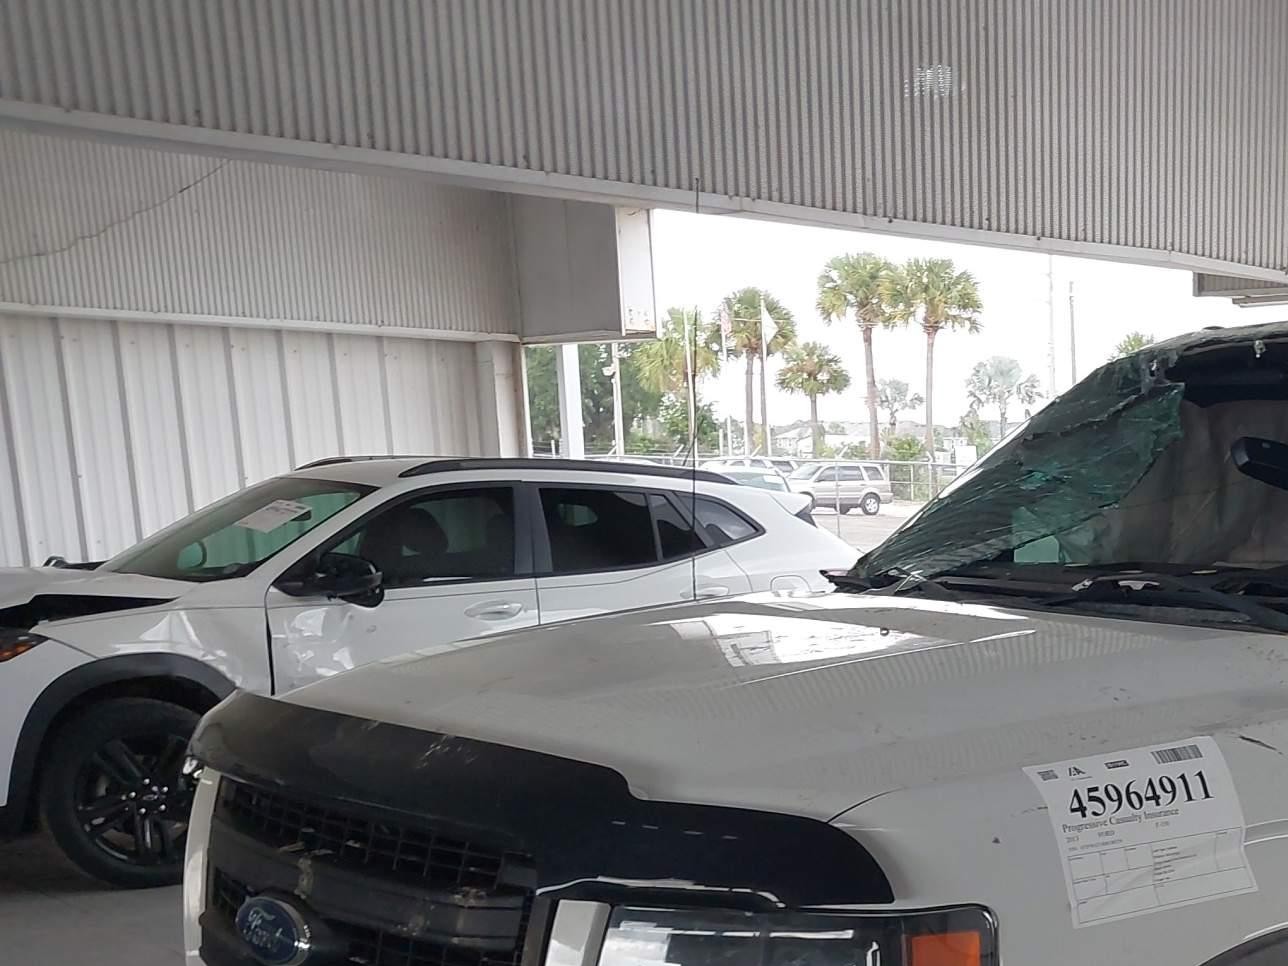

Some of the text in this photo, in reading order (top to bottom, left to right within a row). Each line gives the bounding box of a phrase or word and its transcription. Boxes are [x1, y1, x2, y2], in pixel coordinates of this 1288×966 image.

[1069, 770, 1215, 819] 45964911
[1062, 808, 1180, 833] Progressive Casualty Insurance
[243, 906, 283, 953] Ford
